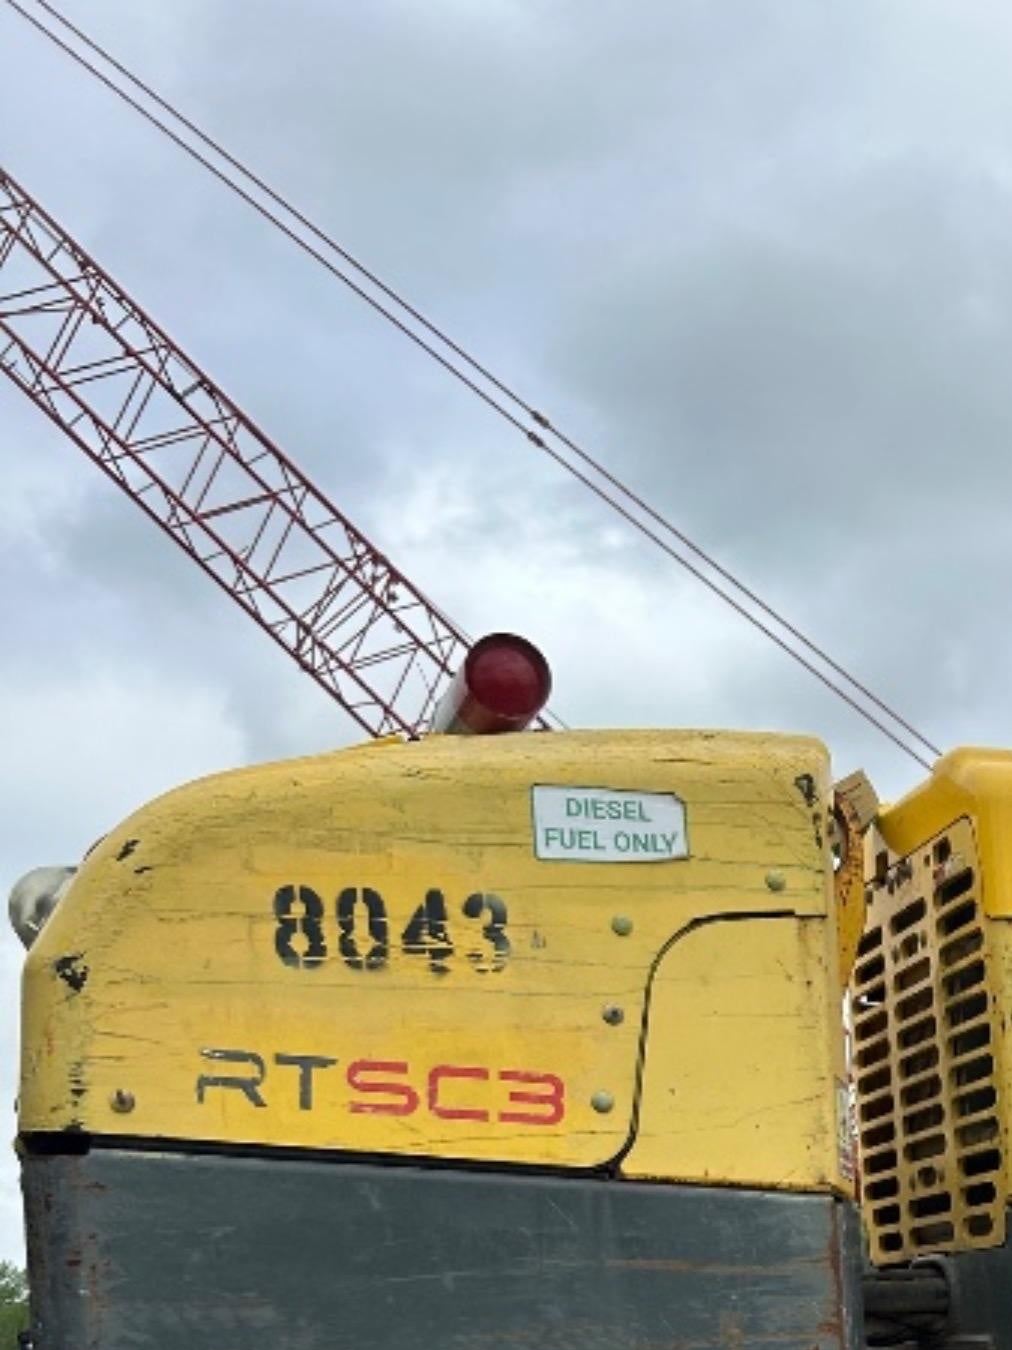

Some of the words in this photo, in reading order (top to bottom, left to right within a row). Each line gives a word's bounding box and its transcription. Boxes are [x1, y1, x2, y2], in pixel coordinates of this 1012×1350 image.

[565, 797, 652, 822] DIESEL
[544, 827, 606, 851] FUEL
[613, 831, 678, 855] ONLY
[272, 884, 510, 977] 8043
[196, 1048, 566, 1126] RTSC3
